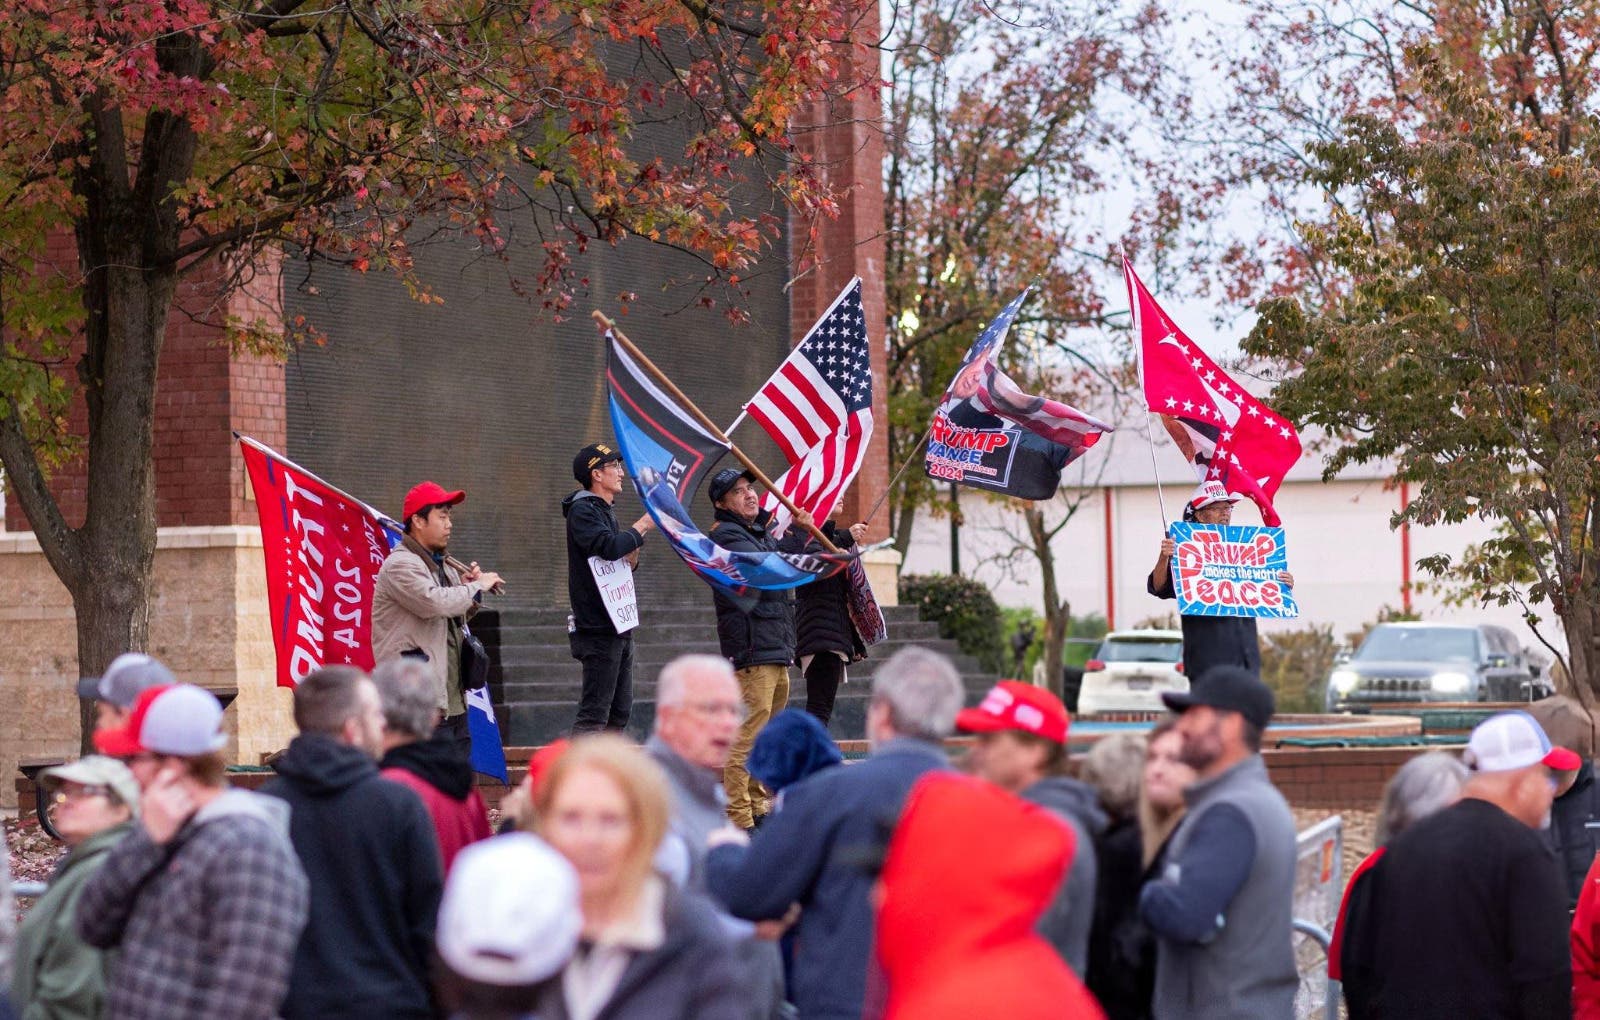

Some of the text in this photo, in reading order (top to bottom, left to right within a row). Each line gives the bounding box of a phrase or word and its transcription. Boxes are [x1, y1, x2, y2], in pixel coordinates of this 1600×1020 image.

[931, 415, 1010, 453] RUMP
[929, 463, 964, 481] 2024
[1192, 531, 1275, 567] TRUMP
[1178, 542, 1281, 606] Peace
[1204, 565, 1236, 579] makes
[1236, 567, 1252, 580] the
